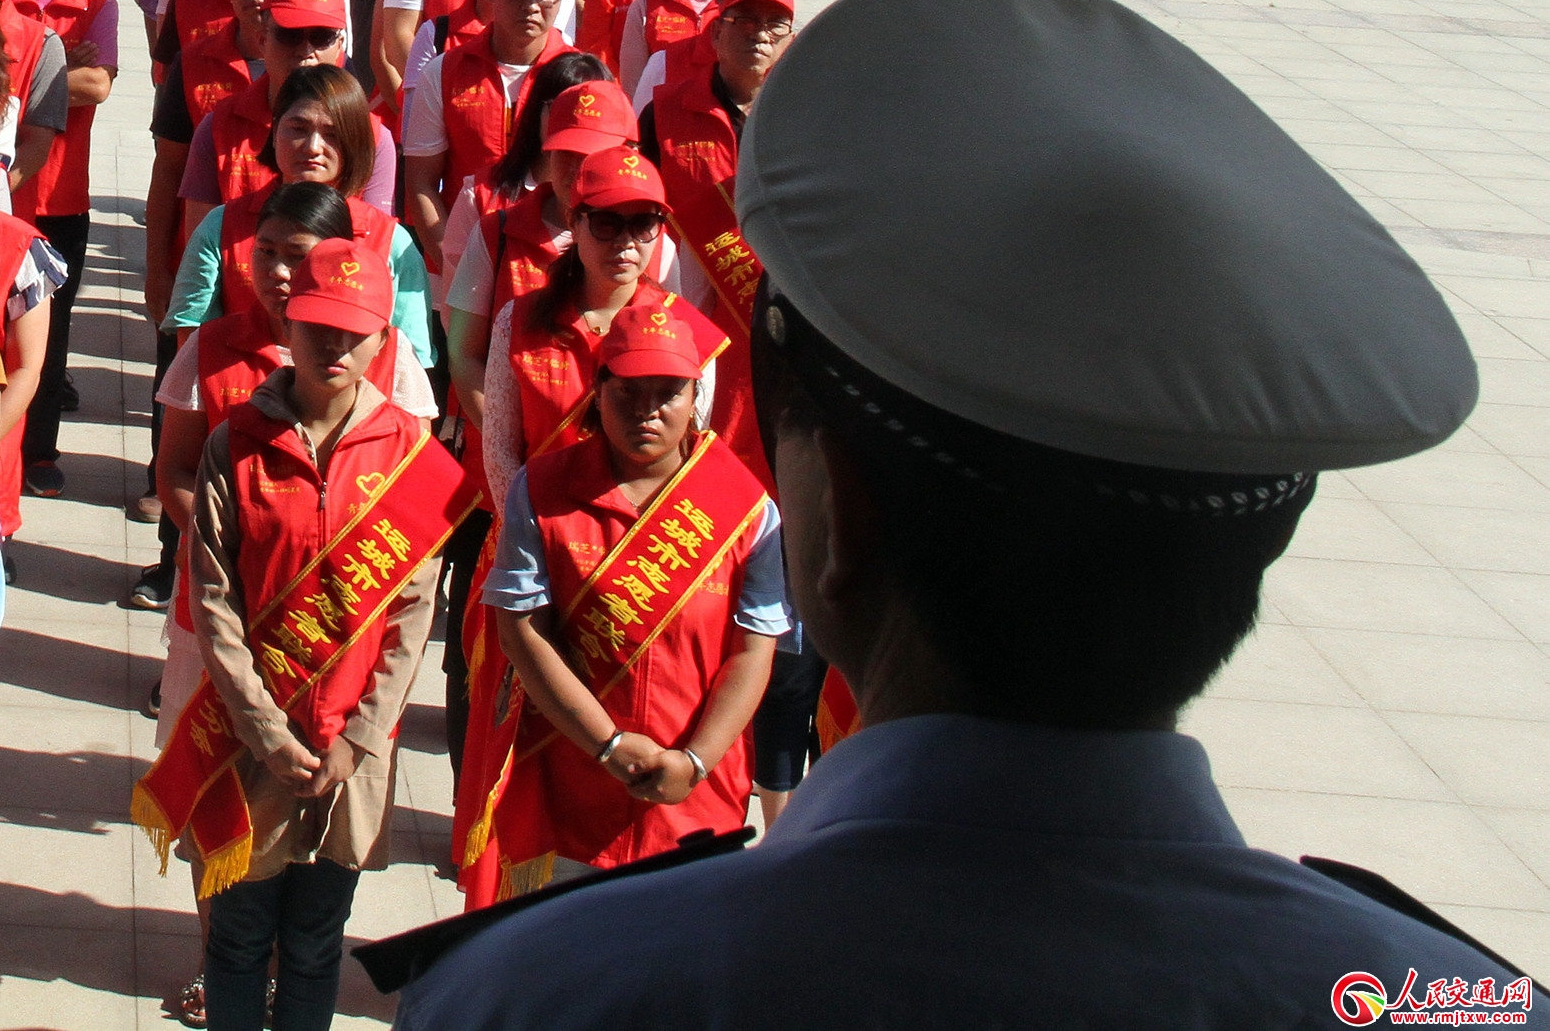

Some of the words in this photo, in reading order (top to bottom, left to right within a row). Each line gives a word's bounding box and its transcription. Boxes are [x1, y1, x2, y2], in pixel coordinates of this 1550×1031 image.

[704, 231, 759, 313] 运城市志
[258, 518, 413, 692] 运城市志愿者联合
